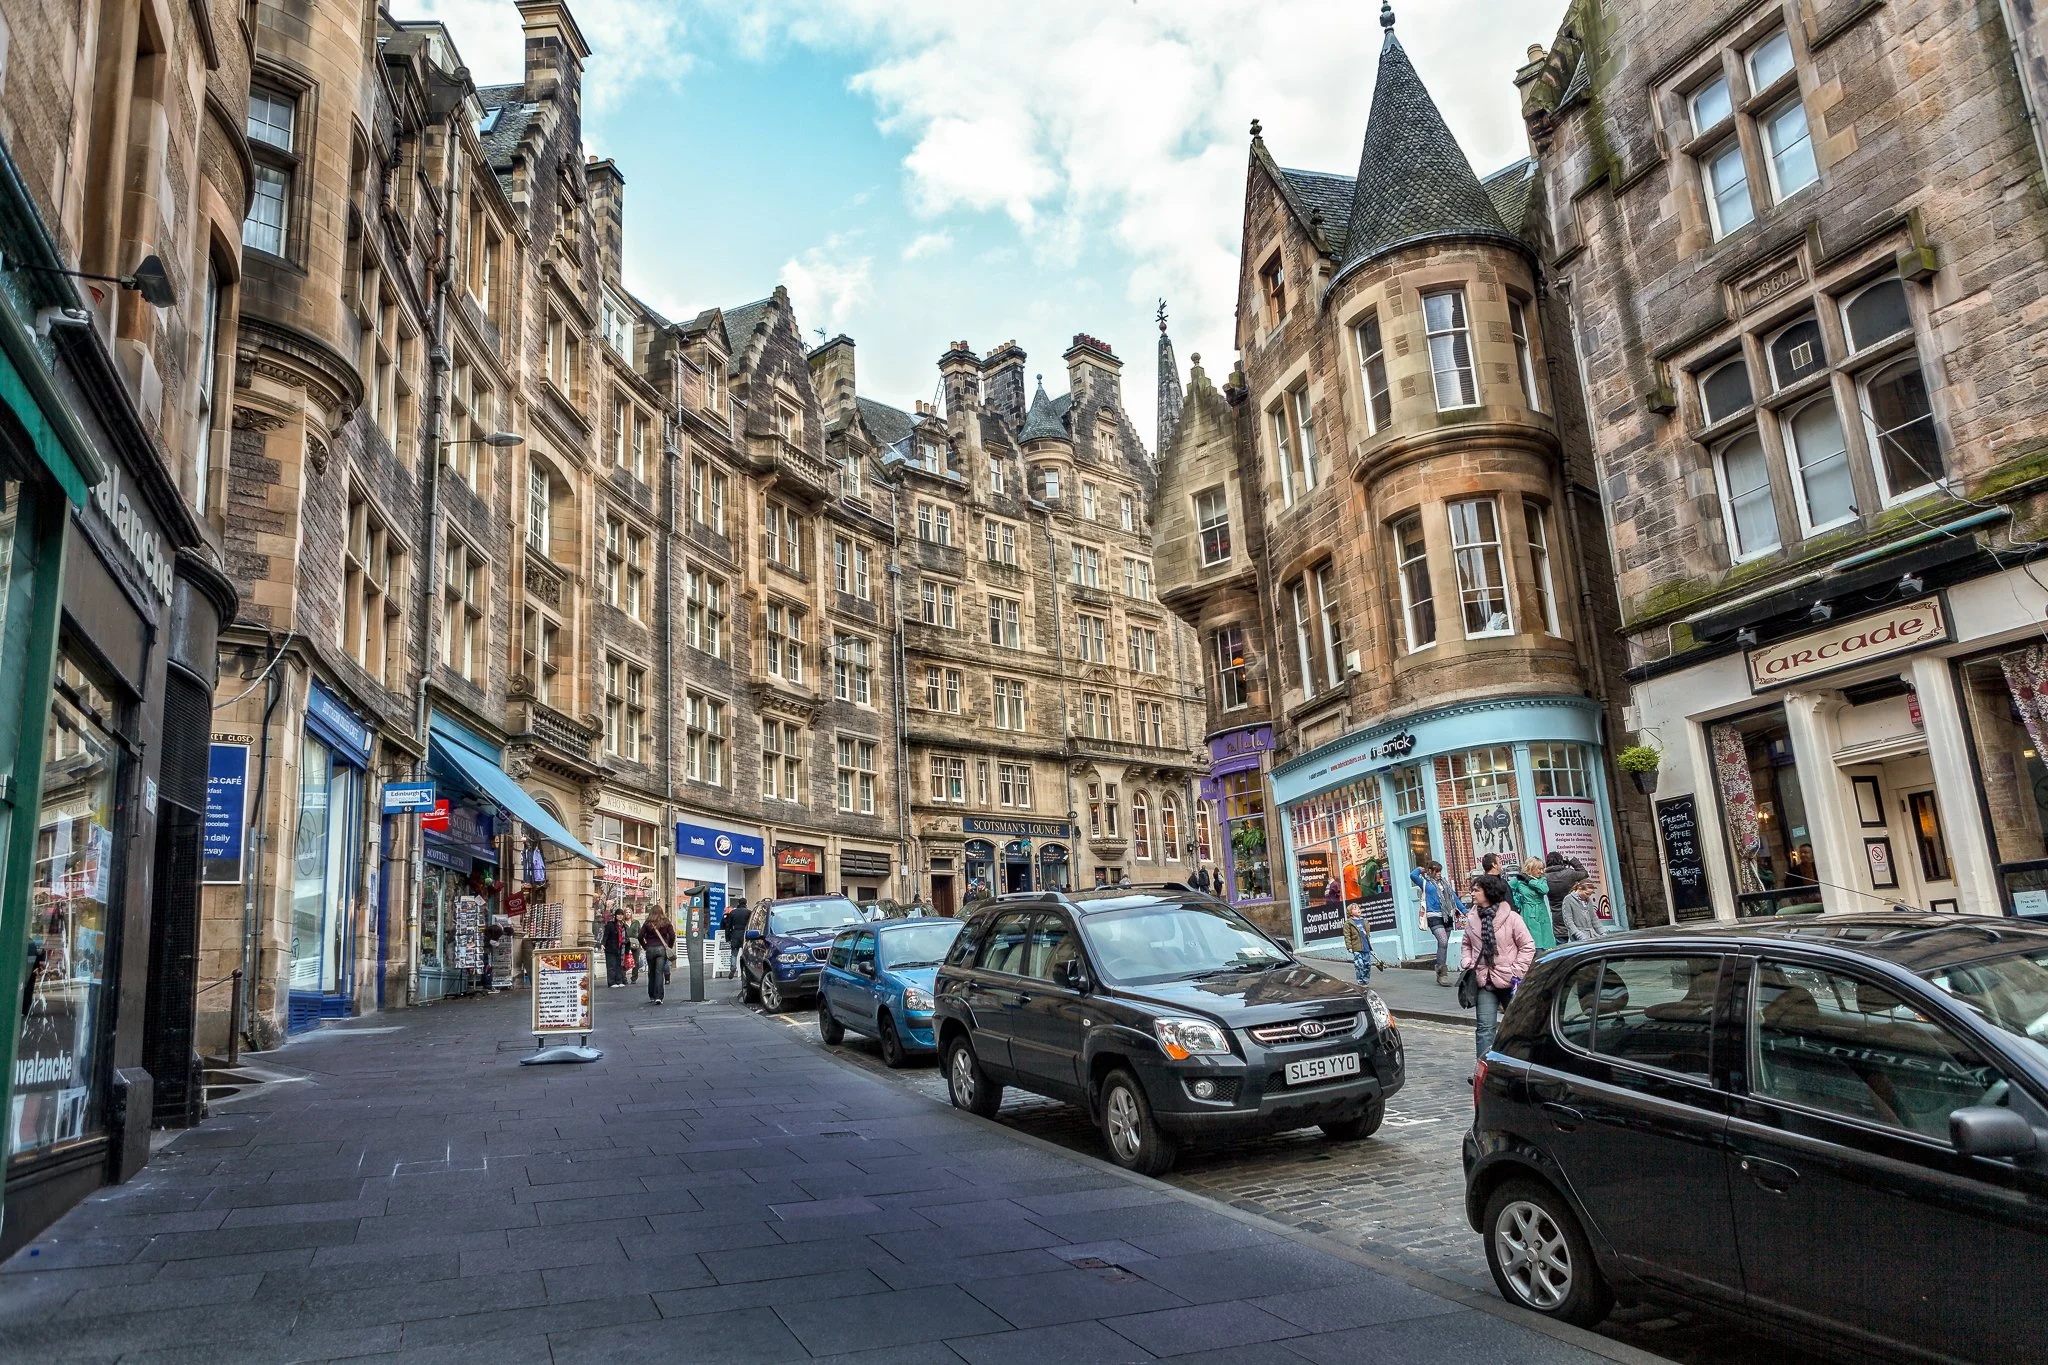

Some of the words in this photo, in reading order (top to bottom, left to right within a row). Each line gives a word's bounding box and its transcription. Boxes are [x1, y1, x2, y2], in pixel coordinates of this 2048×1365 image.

[1757, 271, 1789, 299] 1860
[89, 462, 173, 607] alanche
[1765, 617, 1926, 674] arcade
[228, 735, 251, 743] CLOSE
[1372, 735, 1411, 758] fabrick
[220, 775, 242, 785] CAFÉ
[391, 790, 420, 798] Edinburgh
[606, 796, 626, 811] WHO'S
[628, 802, 642, 815] WHO
[1546, 806, 1581, 818] t-shirt
[453, 814, 484, 838] SCOTSMAN
[1559, 815, 1595, 827] creation
[1660, 812, 1688, 827] FRESH
[973, 820, 1026, 833] SCOTSMAN'S
[1028, 824, 1061, 835] LOUNGE
[211, 833, 230, 844] daily
[690, 836, 705, 846] health
[426, 847, 449, 863] SCOTTISH
[740, 845, 755, 856] beauty
[785, 854, 800, 865] Pizza
[604, 863, 621, 877] SALE
[622, 865, 638, 880] SALE
[1300, 866, 1329, 874] American
[1306, 913, 1322, 923] Come
[1322, 911, 1328, 920] in
[1328, 908, 1339, 920] and
[1303, 924, 1318, 935] make
[1317, 922, 1329, 934] your
[562, 953, 582, 961] YUM
[1303, 1024, 1322, 1034] KIA
[1291, 1060, 1326, 1080] SL59
[1329, 1055, 1355, 1073] YYO
